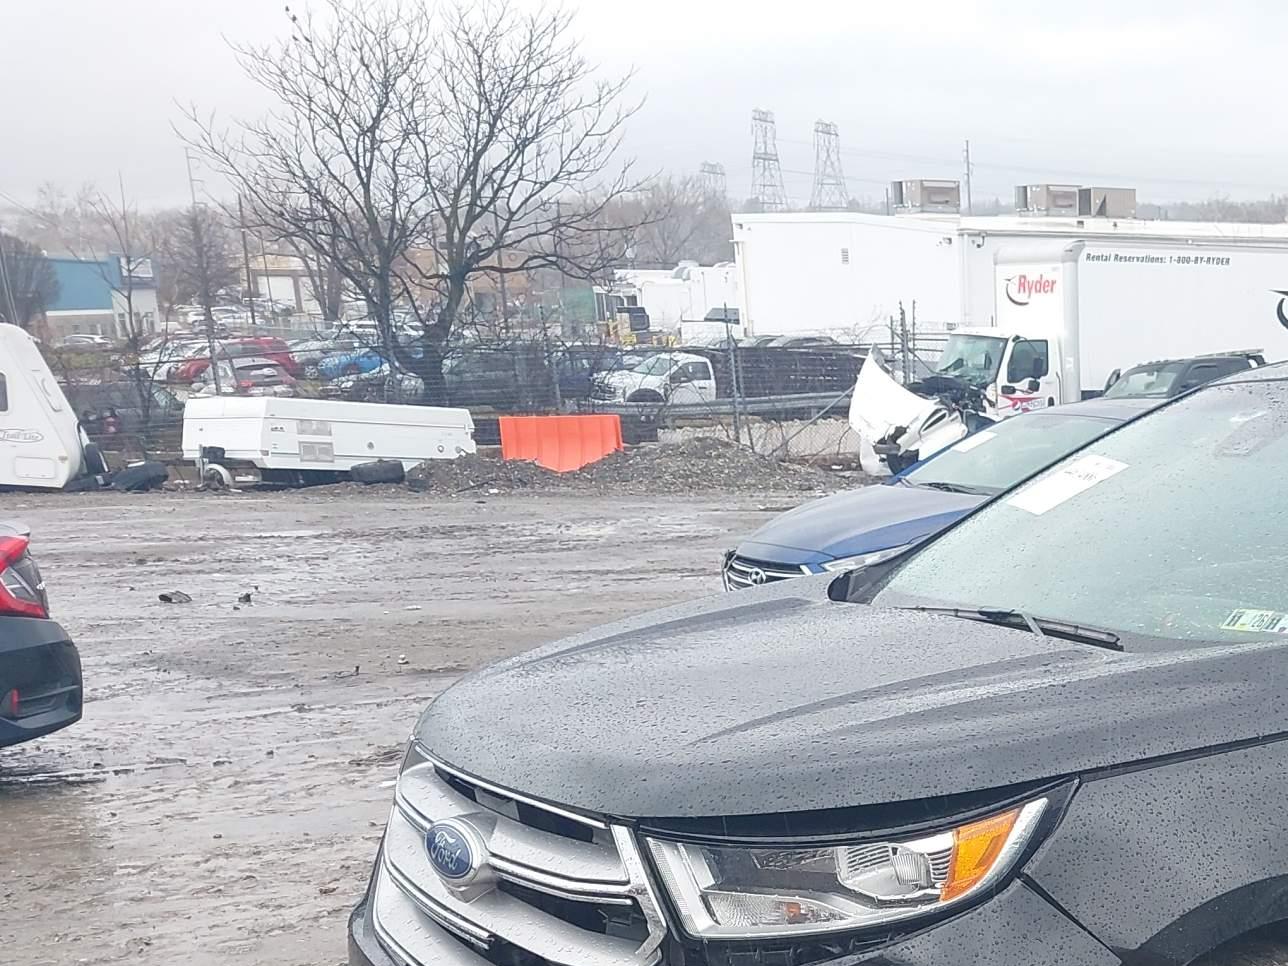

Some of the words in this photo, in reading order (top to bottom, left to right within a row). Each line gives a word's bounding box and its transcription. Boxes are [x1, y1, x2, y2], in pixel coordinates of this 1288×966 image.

[1086, 253, 1111, 262] Rental
[1114, 254, 1166, 264] Reservations:
[1169, 256, 1230, 266] 1-800-BY-RYDER
[1018, 274, 1056, 299] Ryder
[431, 831, 461, 871] Ford
